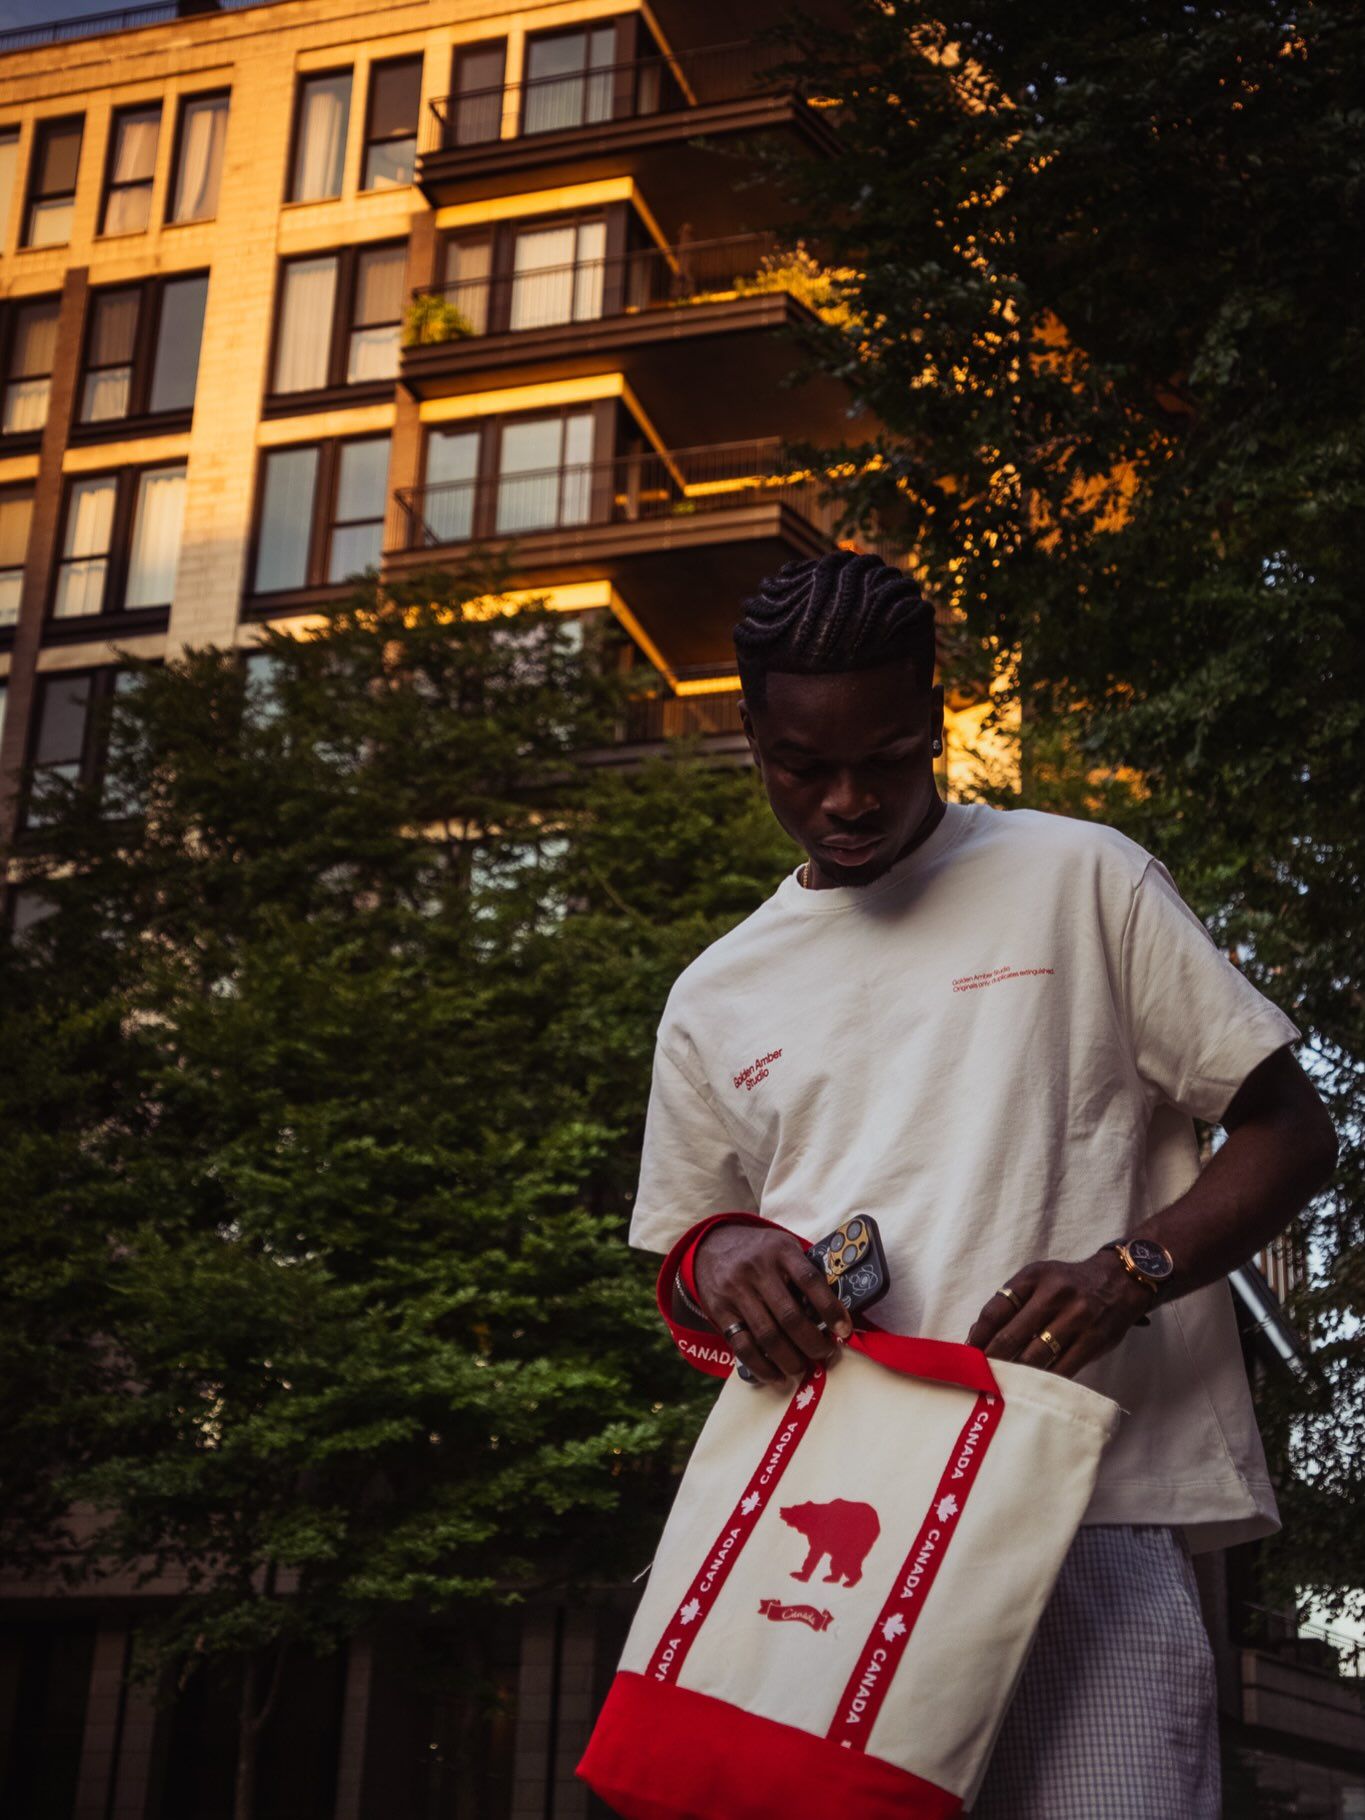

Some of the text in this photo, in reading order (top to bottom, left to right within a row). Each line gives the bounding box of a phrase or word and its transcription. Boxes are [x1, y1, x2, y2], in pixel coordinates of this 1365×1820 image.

[952, 976, 974, 986] Golden
[974, 971, 993, 981] Amber
[953, 981, 978, 992] Originals
[733, 1048, 783, 1089] Golden Amber
[746, 1069, 769, 1091] Studio
[700, 1528, 741, 1592] CANADA
[760, 1422, 798, 1484] CANADA
[846, 1412, 989, 1723] CANADA CANADA CANADA
[782, 1608, 815, 1625] Canada
